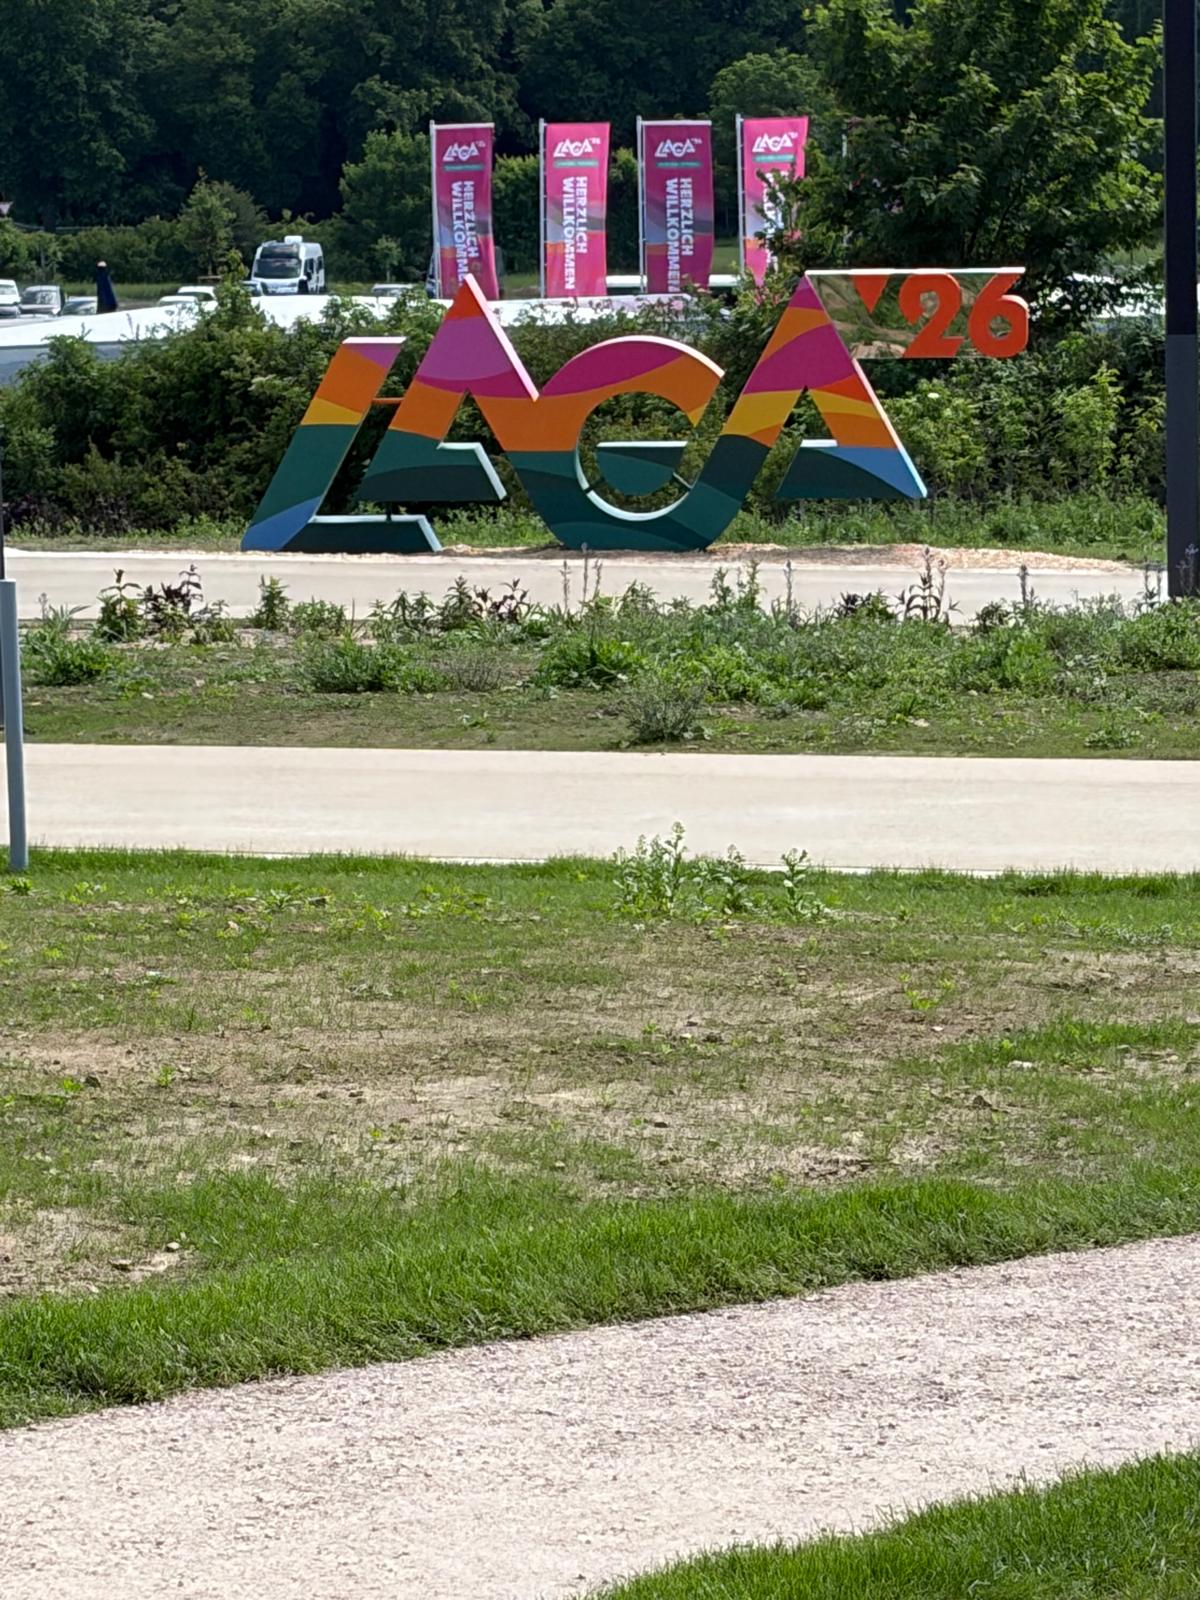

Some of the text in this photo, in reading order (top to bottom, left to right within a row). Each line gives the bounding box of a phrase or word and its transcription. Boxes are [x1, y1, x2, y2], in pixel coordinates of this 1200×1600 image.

[451, 181, 470, 285] WILLKOMME
[463, 180, 479, 258] HERZLICH
[562, 176, 575, 289] WILLKOMMEN
[576, 176, 588, 254] HERZLICH
[680, 177, 694, 256] HERZLICH
[241, 274, 928, 553] LAGA
